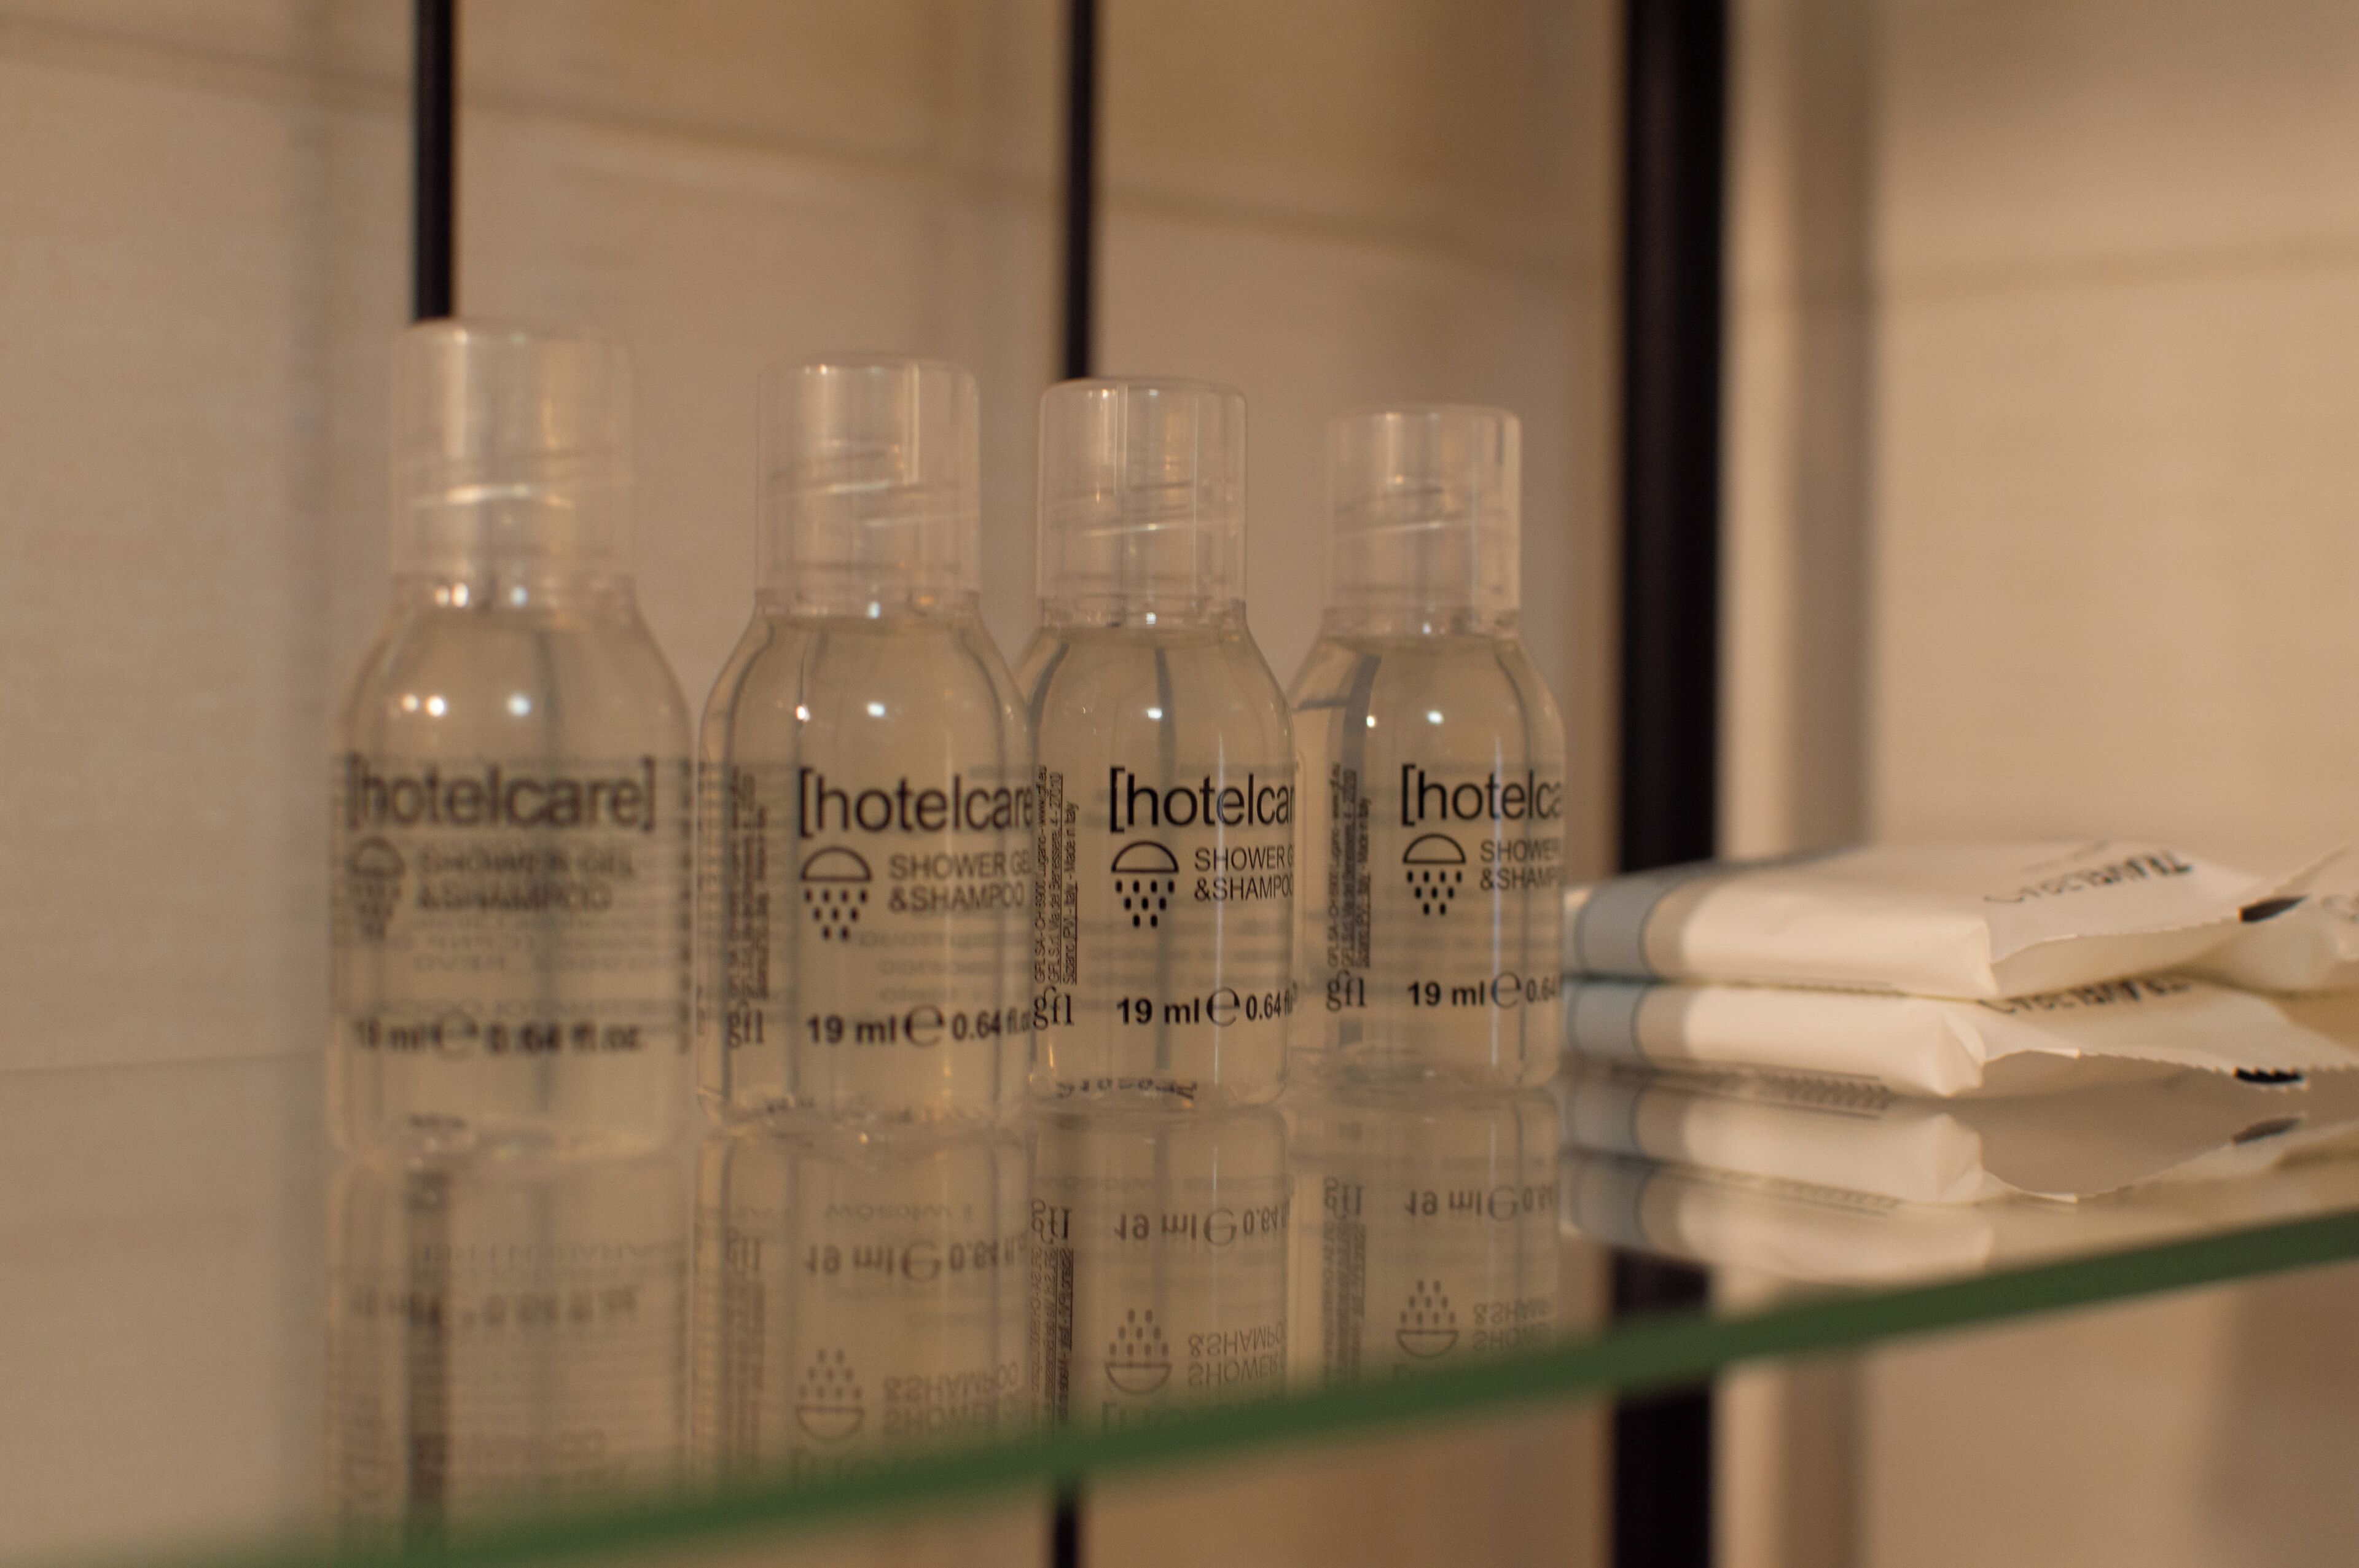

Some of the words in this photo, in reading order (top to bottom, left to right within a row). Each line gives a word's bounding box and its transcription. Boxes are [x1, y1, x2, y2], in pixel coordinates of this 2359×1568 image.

[888, 851, 1006, 881] SHOWER
[1194, 845, 1285, 872] SHOWER
[888, 882, 1025, 913] &SHAMPOO
[1117, 997, 1153, 1025] 19
[1164, 997, 1200, 1025] ml
[1245, 992, 1281, 1022] 0.64
[1407, 981, 1442, 1007] 19
[1452, 980, 1485, 1007] ml
[807, 1014, 844, 1045] 19
[856, 1014, 897, 1045] ml
[952, 1009, 1001, 1041] 0.64
